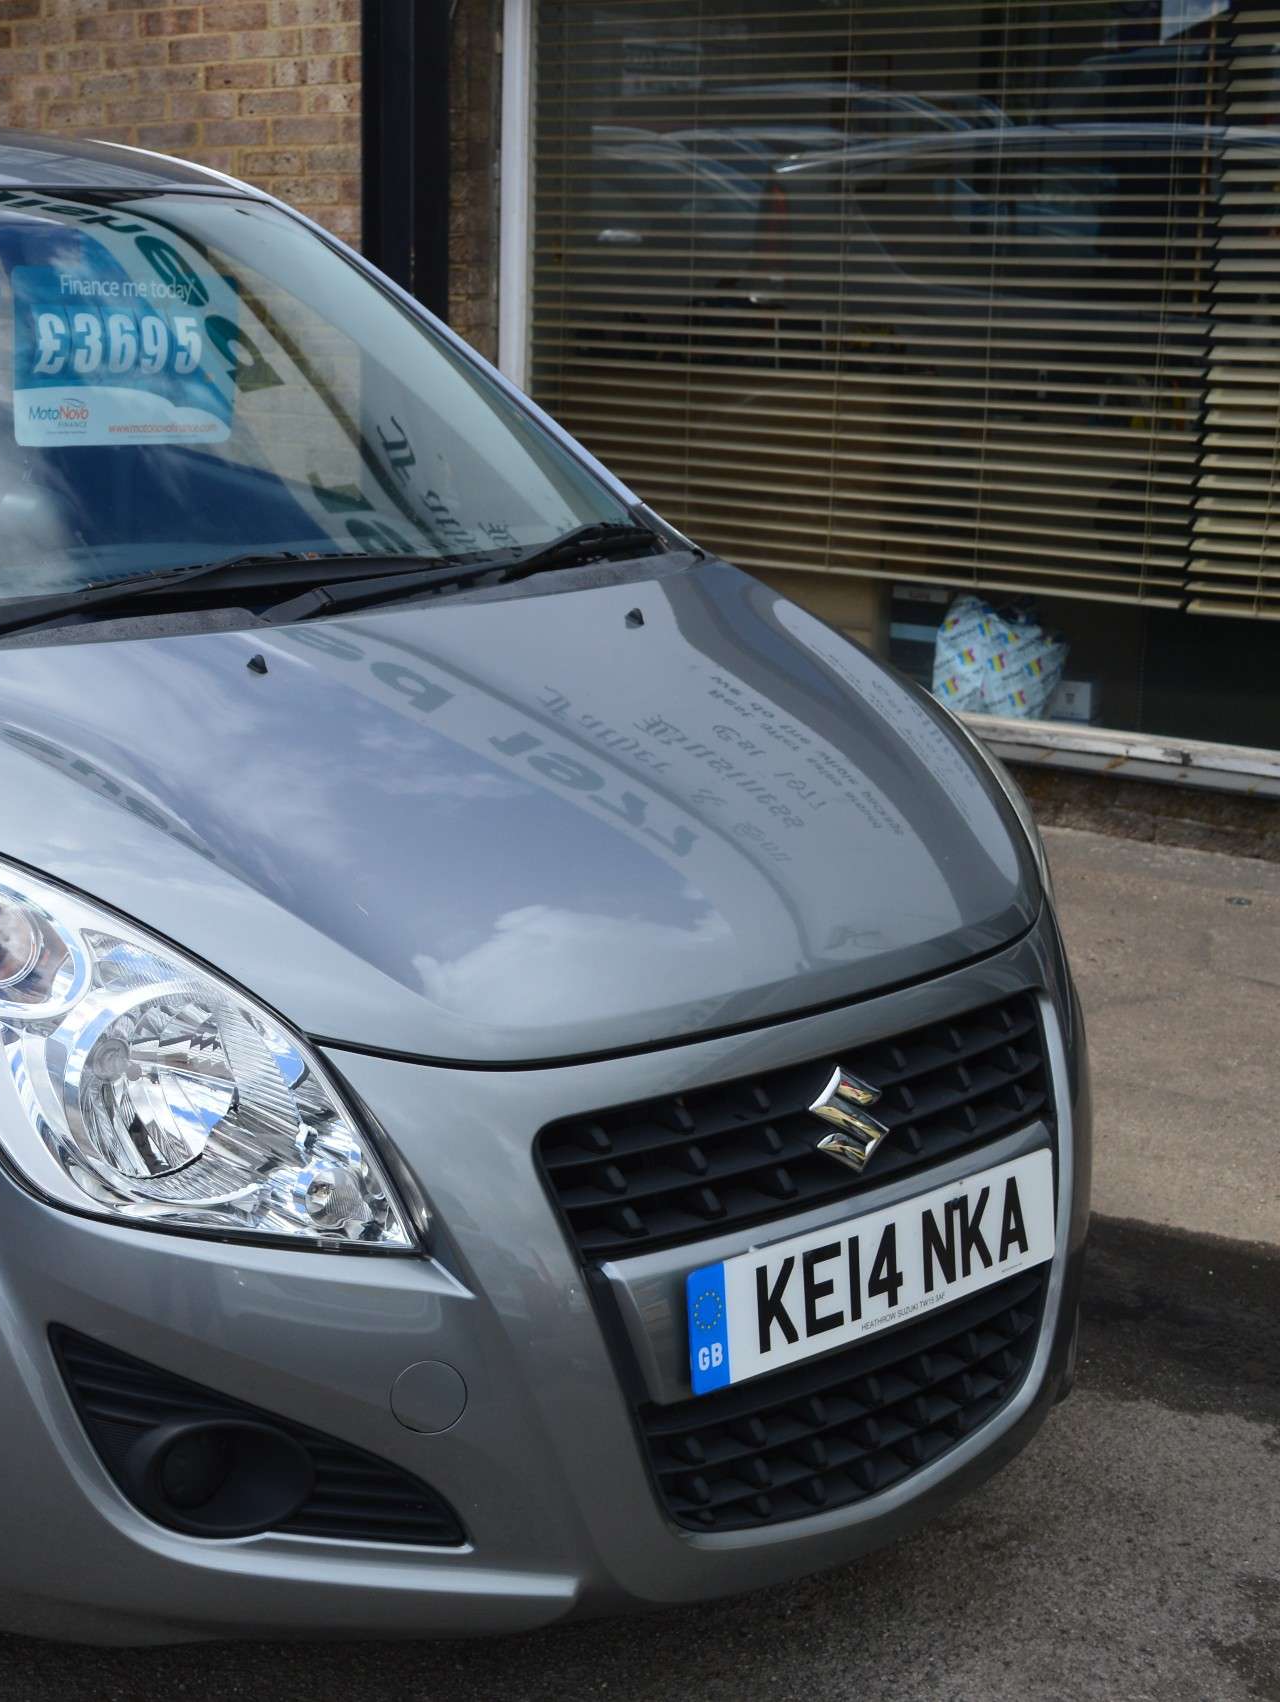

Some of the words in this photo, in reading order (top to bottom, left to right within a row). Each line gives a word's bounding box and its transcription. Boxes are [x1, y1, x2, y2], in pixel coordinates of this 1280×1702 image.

[60, 275, 119, 298] Finance
[123, 282, 148, 298] me
[150, 279, 194, 304] today
[33, 312, 203, 375] £3695
[29, 407, 90, 421] MotoNovo
[755, 1221, 904, 1355] KE14
[922, 1176, 1029, 1294] NKA
[698, 1342, 723, 1371] GB
